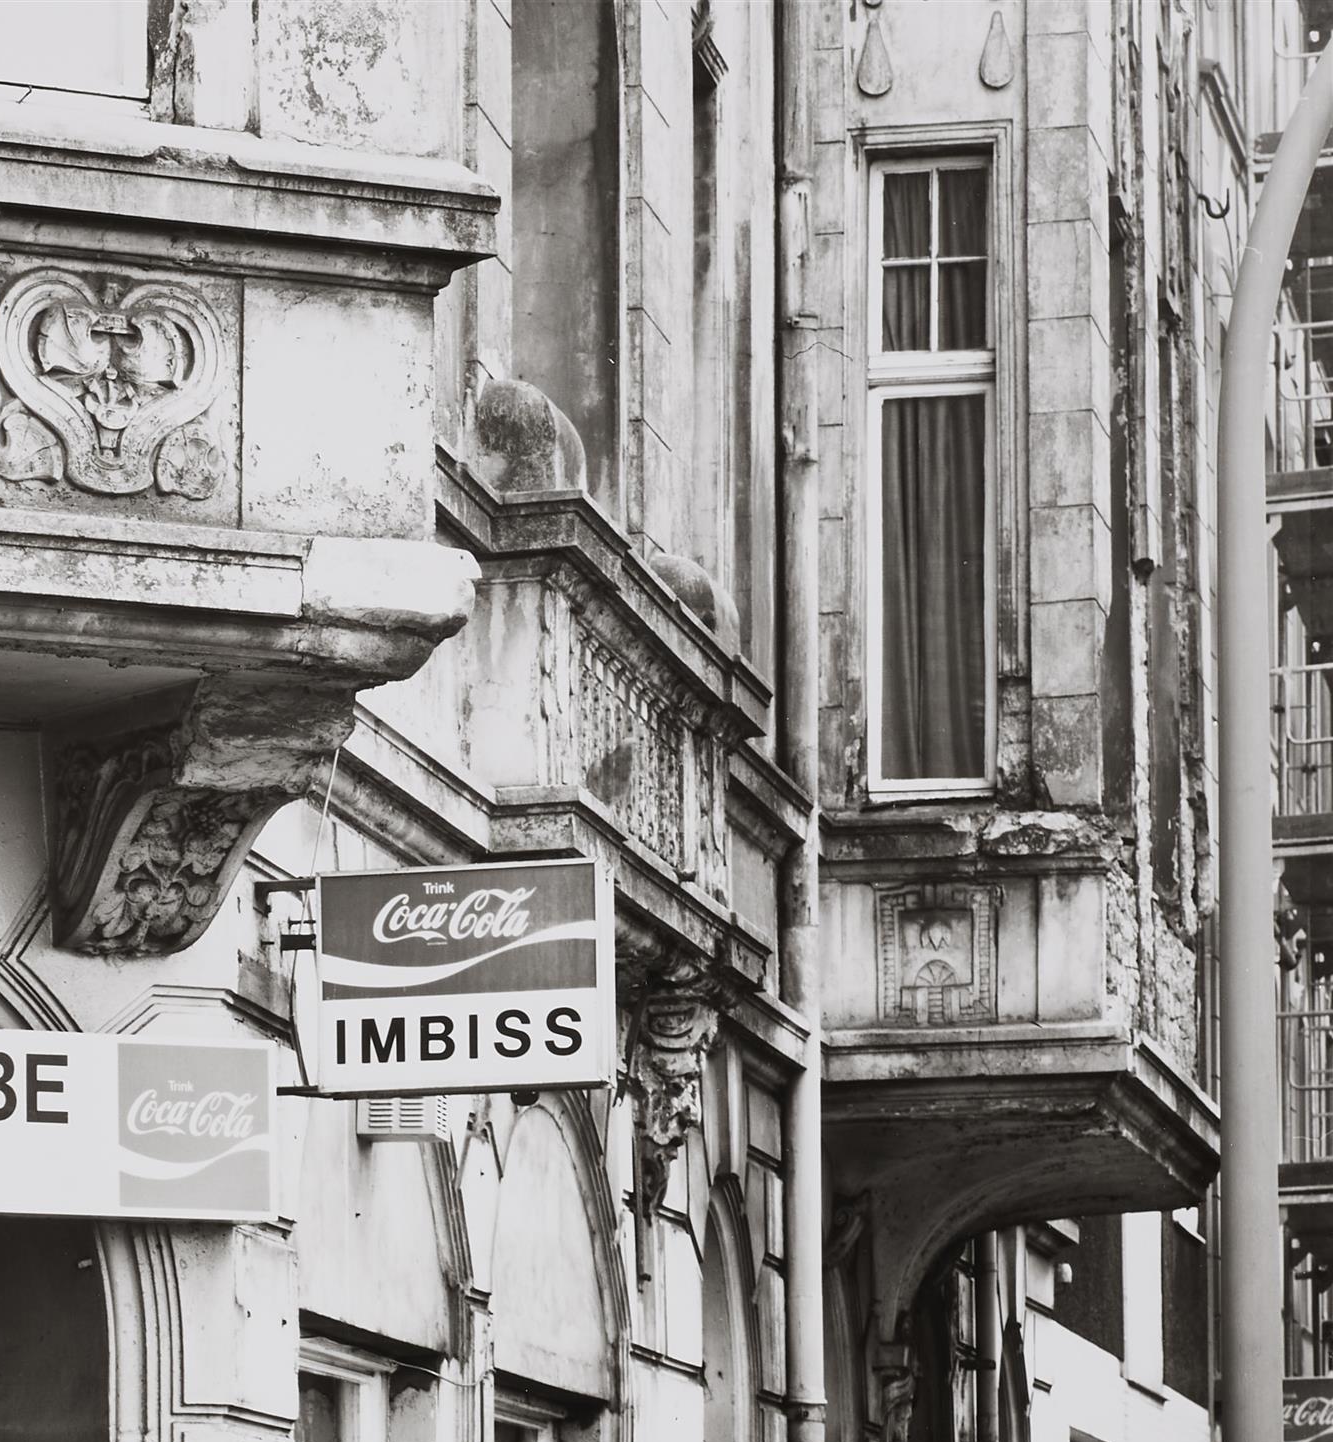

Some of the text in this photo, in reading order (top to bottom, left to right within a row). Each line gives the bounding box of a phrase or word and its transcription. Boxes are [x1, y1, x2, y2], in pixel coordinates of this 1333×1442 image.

[422, 881, 455, 895] Trink
[372, 886, 537, 944] Coca-Cola
[336, 1007, 582, 1065] IMBISS
[167, 1079, 194, 1093] Trink
[126, 1089, 258, 1138] Coca-Cola
